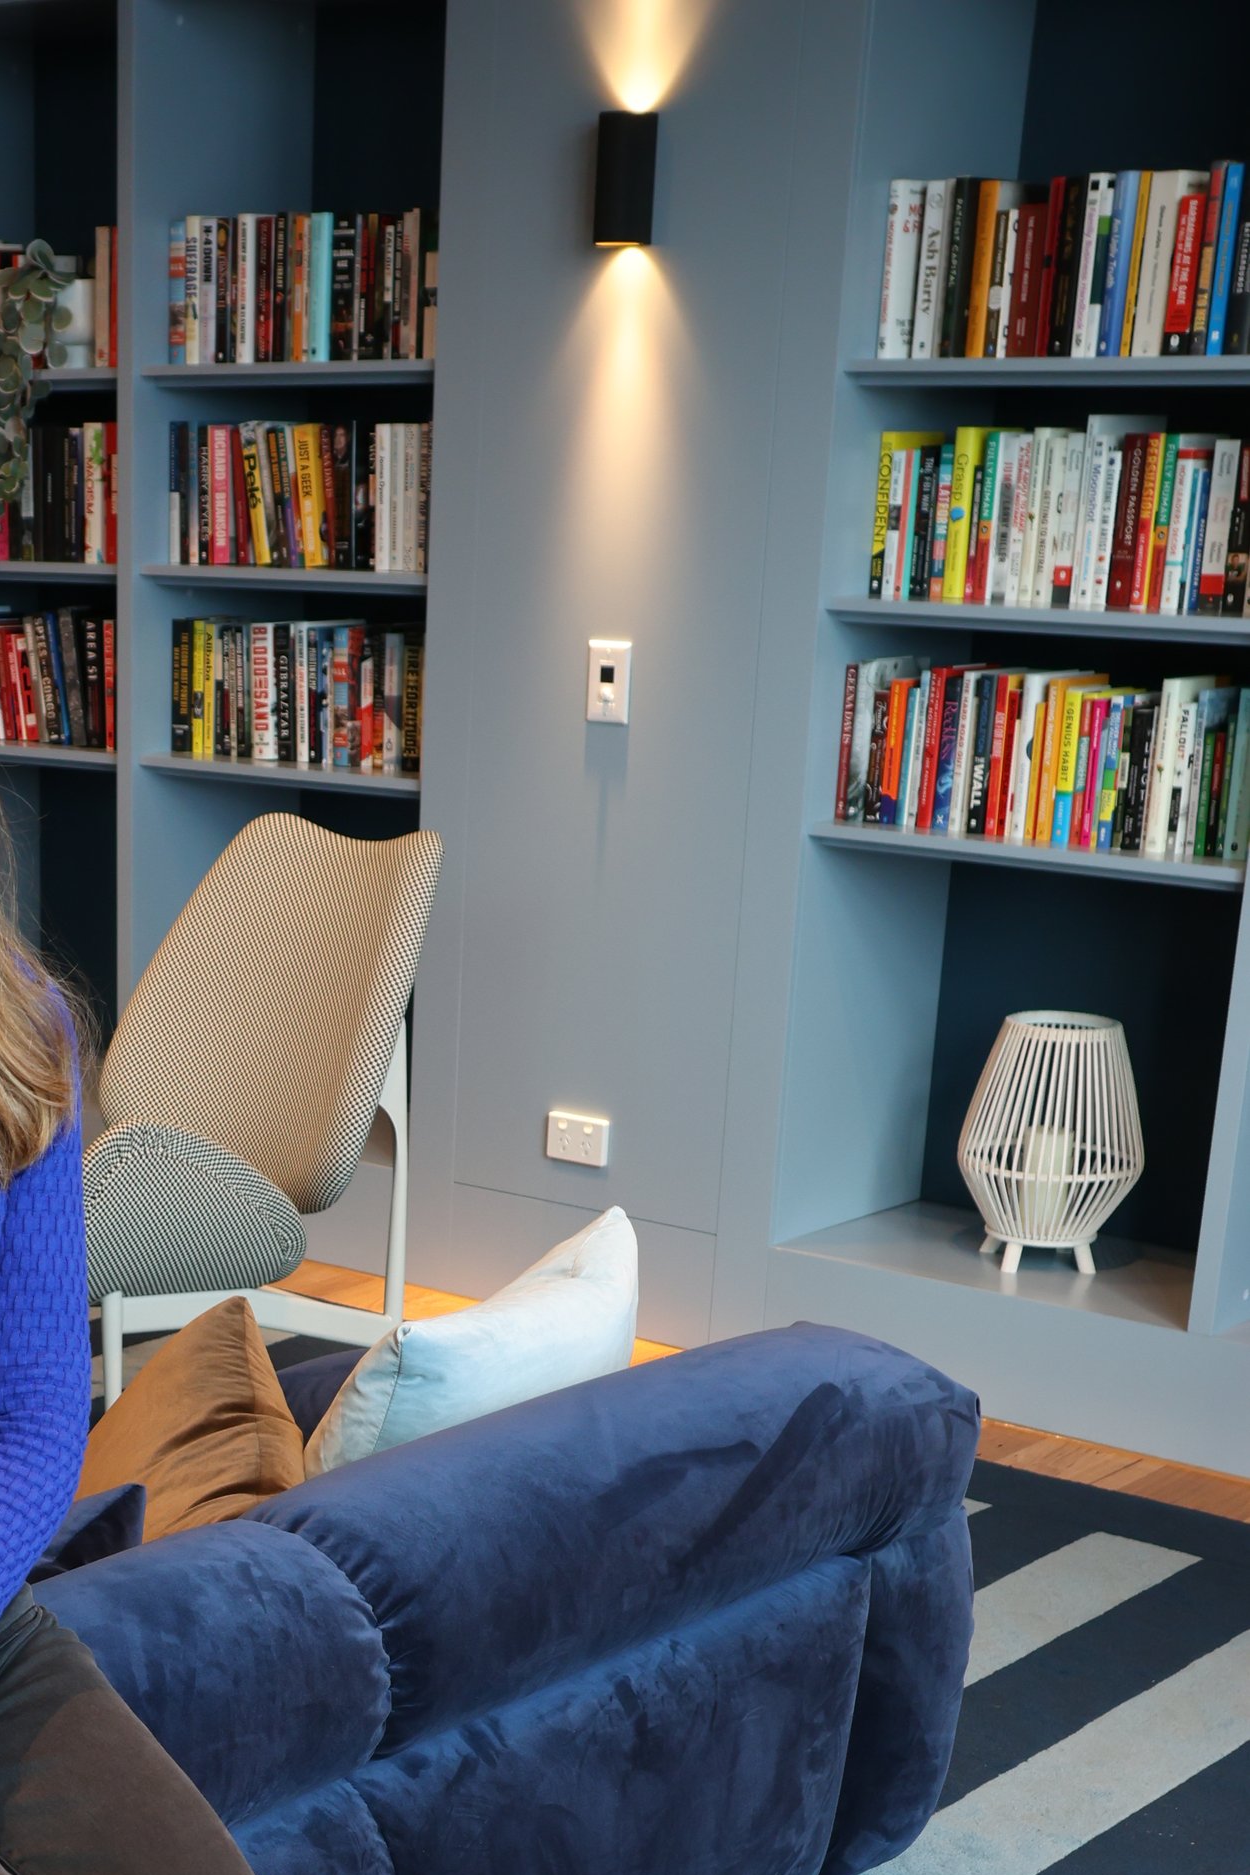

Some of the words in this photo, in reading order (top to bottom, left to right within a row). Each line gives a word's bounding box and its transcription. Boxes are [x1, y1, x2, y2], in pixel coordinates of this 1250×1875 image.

[953, 198, 963, 241] PATIENT
[1113, 218, 1121, 234] An
[1183, 200, 1199, 253] BARBARIANS
[927, 225, 941, 260] Ash
[1109, 234, 1120, 258] Ugly
[185, 237, 197, 299] SUFFRAGE
[203, 247, 213, 283] DOWN
[949, 244, 959, 288] CAPITAL
[1106, 259, 1117, 288] Truth
[1180, 267, 1191, 282] THE
[922, 266, 938, 316] Barty
[1176, 284, 1188, 305] GATE
[214, 429, 226, 481] RICHARD
[298, 439, 310, 461] JUST
[321, 430, 330, 467] GEENA
[924, 456, 934, 474] THE
[987, 440, 996, 474] FULLY
[1165, 442, 1176, 475] FULLY
[86, 457, 94, 514] MAOISM
[200, 446, 208, 491] HARRY
[244, 453, 261, 510] Pelé
[302, 473, 313, 498] GEEK
[324, 468, 333, 499] DAVIS
[923, 476, 931, 491] FBI
[952, 453, 969, 502] Grasp
[1130, 447, 1142, 492] GOLDEN
[1140, 438, 1159, 520] PERSUASION
[874, 452, 892, 545] CONFIDENT
[921, 493, 929, 513] WAY
[936, 473, 952, 535] PLATFORM
[982, 477, 993, 517] HUMAN
[1040, 490, 1051, 525] GETTING
[1087, 463, 1102, 522] Moonshot
[1102, 468, 1115, 511] EVERYONE'S
[1159, 477, 1171, 515] HUMAN
[201, 494, 209, 542] STYLES
[215, 492, 227, 547] BRANSON
[1040, 527, 1048, 536] TO
[1124, 495, 1136, 546] PASSPORT
[998, 532, 1009, 563] MILLER
[1037, 538, 1048, 574] NEUTRAL
[1099, 528, 1109, 553] ARTIST
[86, 621, 97, 660] AREA
[252, 626, 268, 676] BLOOD
[34, 617, 48, 658] SPIES
[42, 677, 57, 720] CONGO
[87, 665, 99, 681] 51
[106, 657, 114, 683] BET
[406, 648, 420, 677] FIRE
[21, 651, 32, 714] ALI
[279, 655, 289, 736] GIBRALTAR
[845, 668, 856, 710] GEENA
[928, 673, 937, 701] HARRY
[963, 678, 971, 694] THE
[254, 690, 269, 731] SAND
[404, 684, 418, 756] FORTITUDE
[960, 696, 969, 721] HARD
[1062, 708, 1074, 747] GENIUS
[842, 711, 854, 745] DAVIS
[958, 723, 966, 749] ROAD
[1177, 709, 1190, 760] FALLOUT
[956, 751, 964, 768] OUT
[1060, 750, 1071, 783] HABIT
[970, 763, 986, 809] WALL
